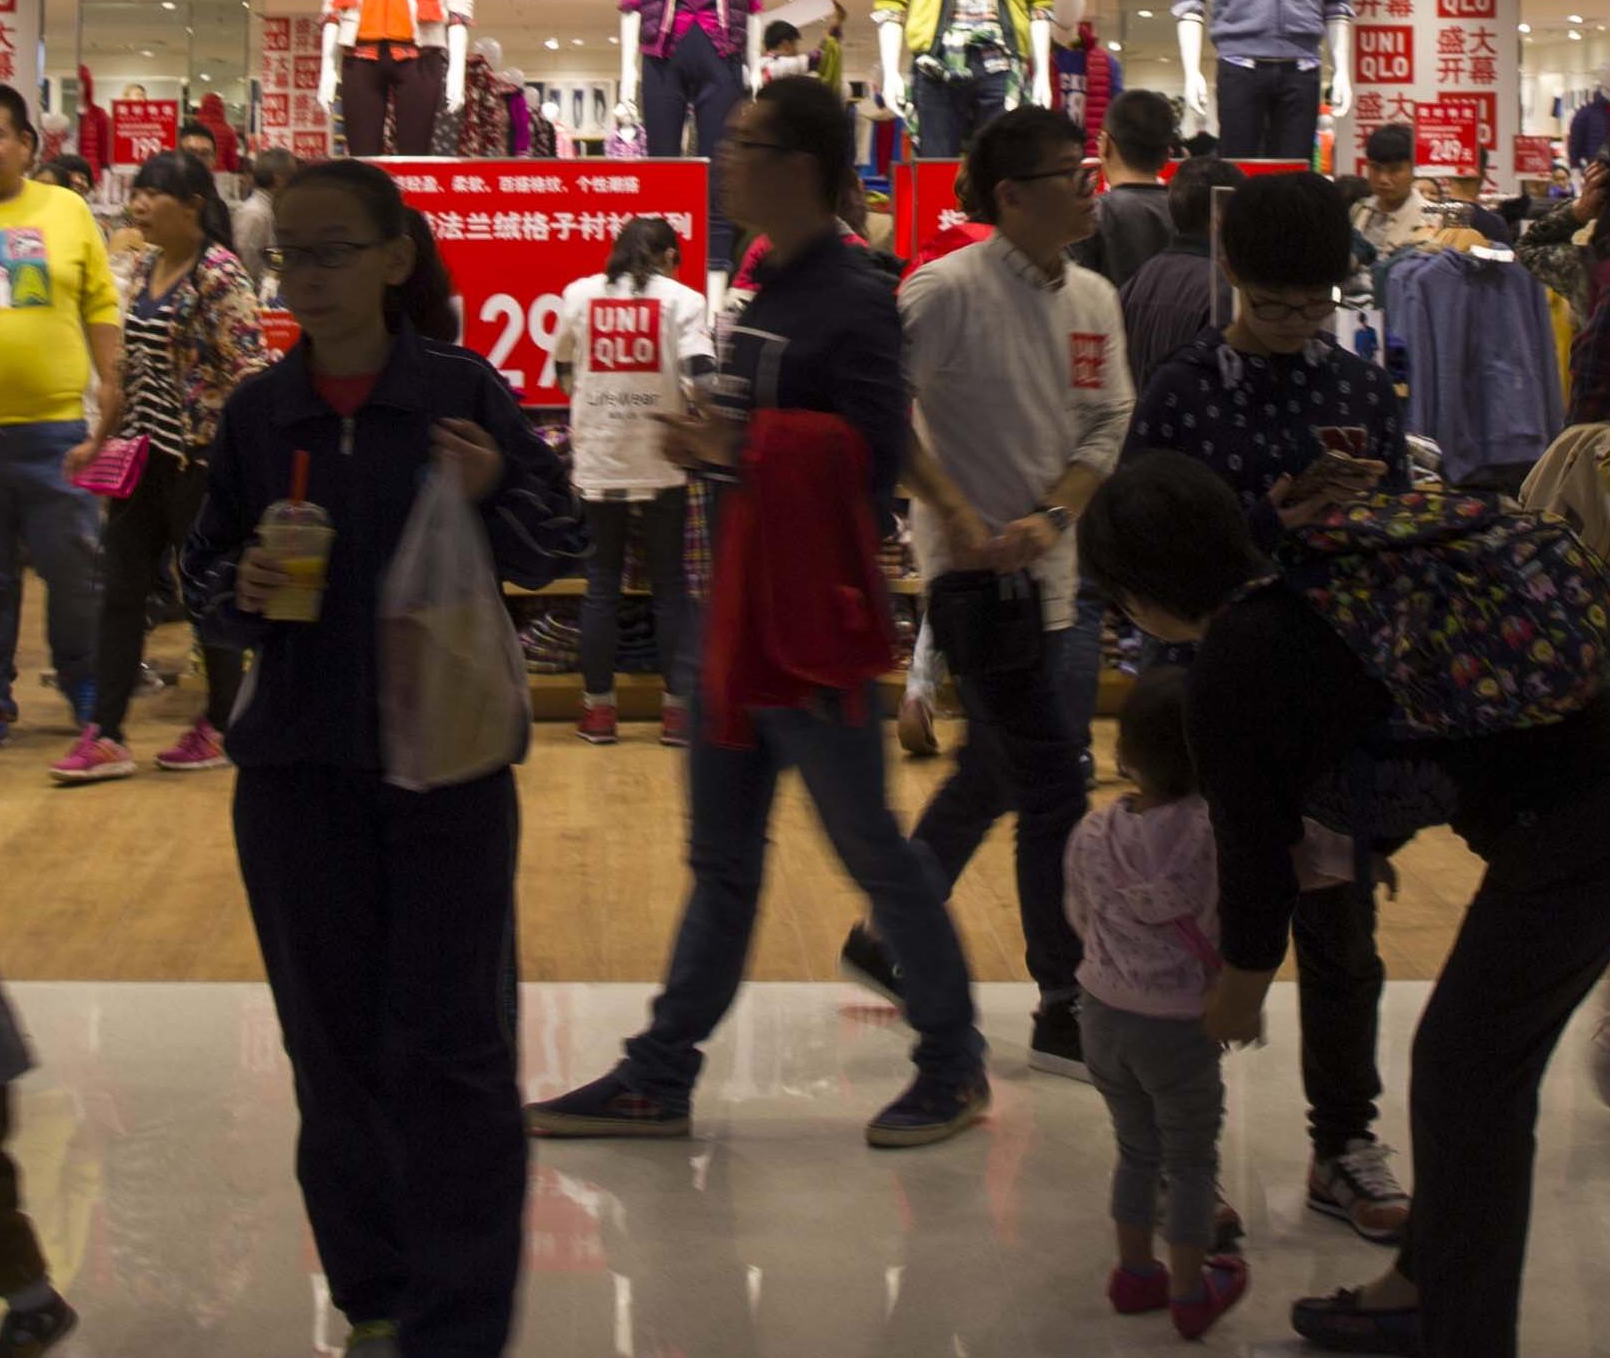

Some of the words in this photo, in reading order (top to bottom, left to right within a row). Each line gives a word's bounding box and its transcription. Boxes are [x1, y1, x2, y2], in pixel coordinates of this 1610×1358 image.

[1359, 31, 1405, 53] UNI
[1436, 25, 1497, 54] 盛大
[1359, 56, 1409, 80] QLO
[1436, 55, 1498, 84] 开幕
[1354, 92, 1414, 121] 盛大
[593, 306, 651, 332] UNI
[593, 337, 655, 368] QLO
